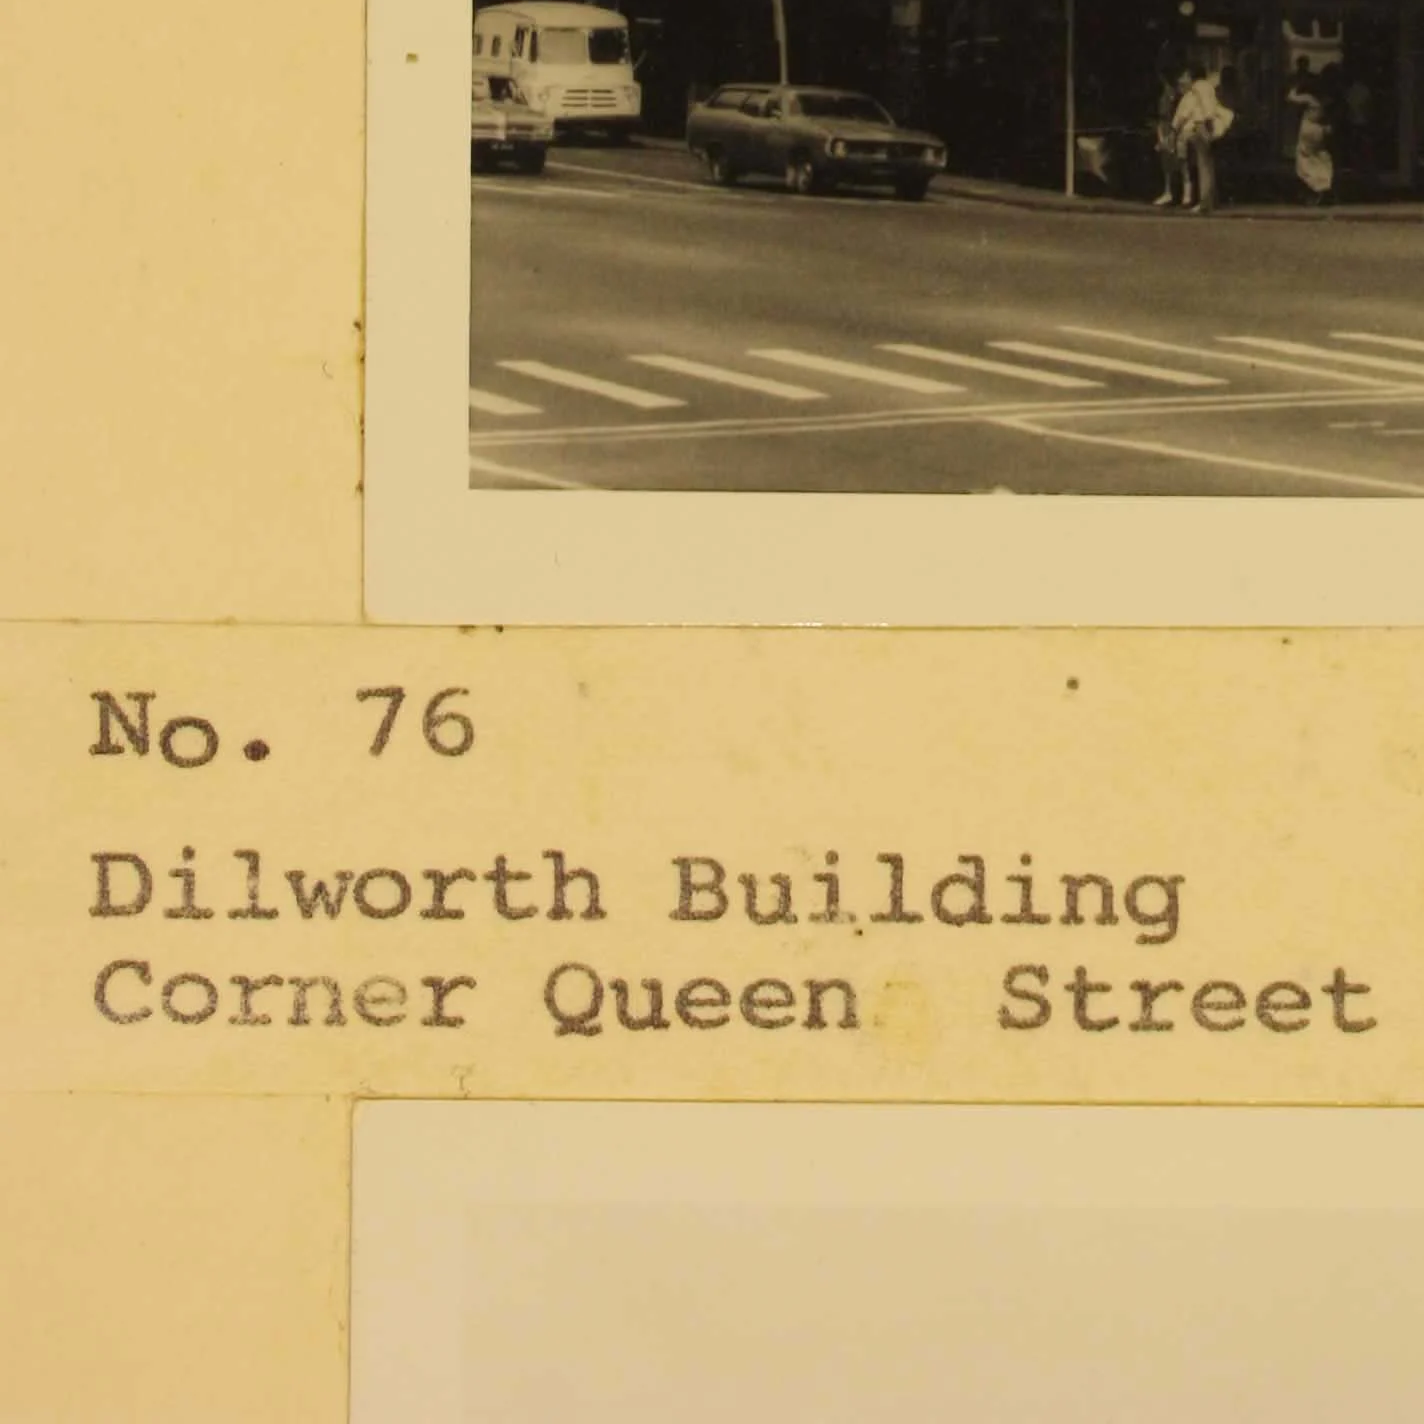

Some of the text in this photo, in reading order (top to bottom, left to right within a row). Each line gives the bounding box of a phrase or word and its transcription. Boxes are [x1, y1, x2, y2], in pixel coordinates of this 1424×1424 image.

[88, 685, 475, 769] No. 76
[88, 845, 1186, 944] Dilworth Building
[93, 959, 477, 1029] Corner
[543, 962, 860, 1037] Queen
[998, 964, 1378, 1034] Street
